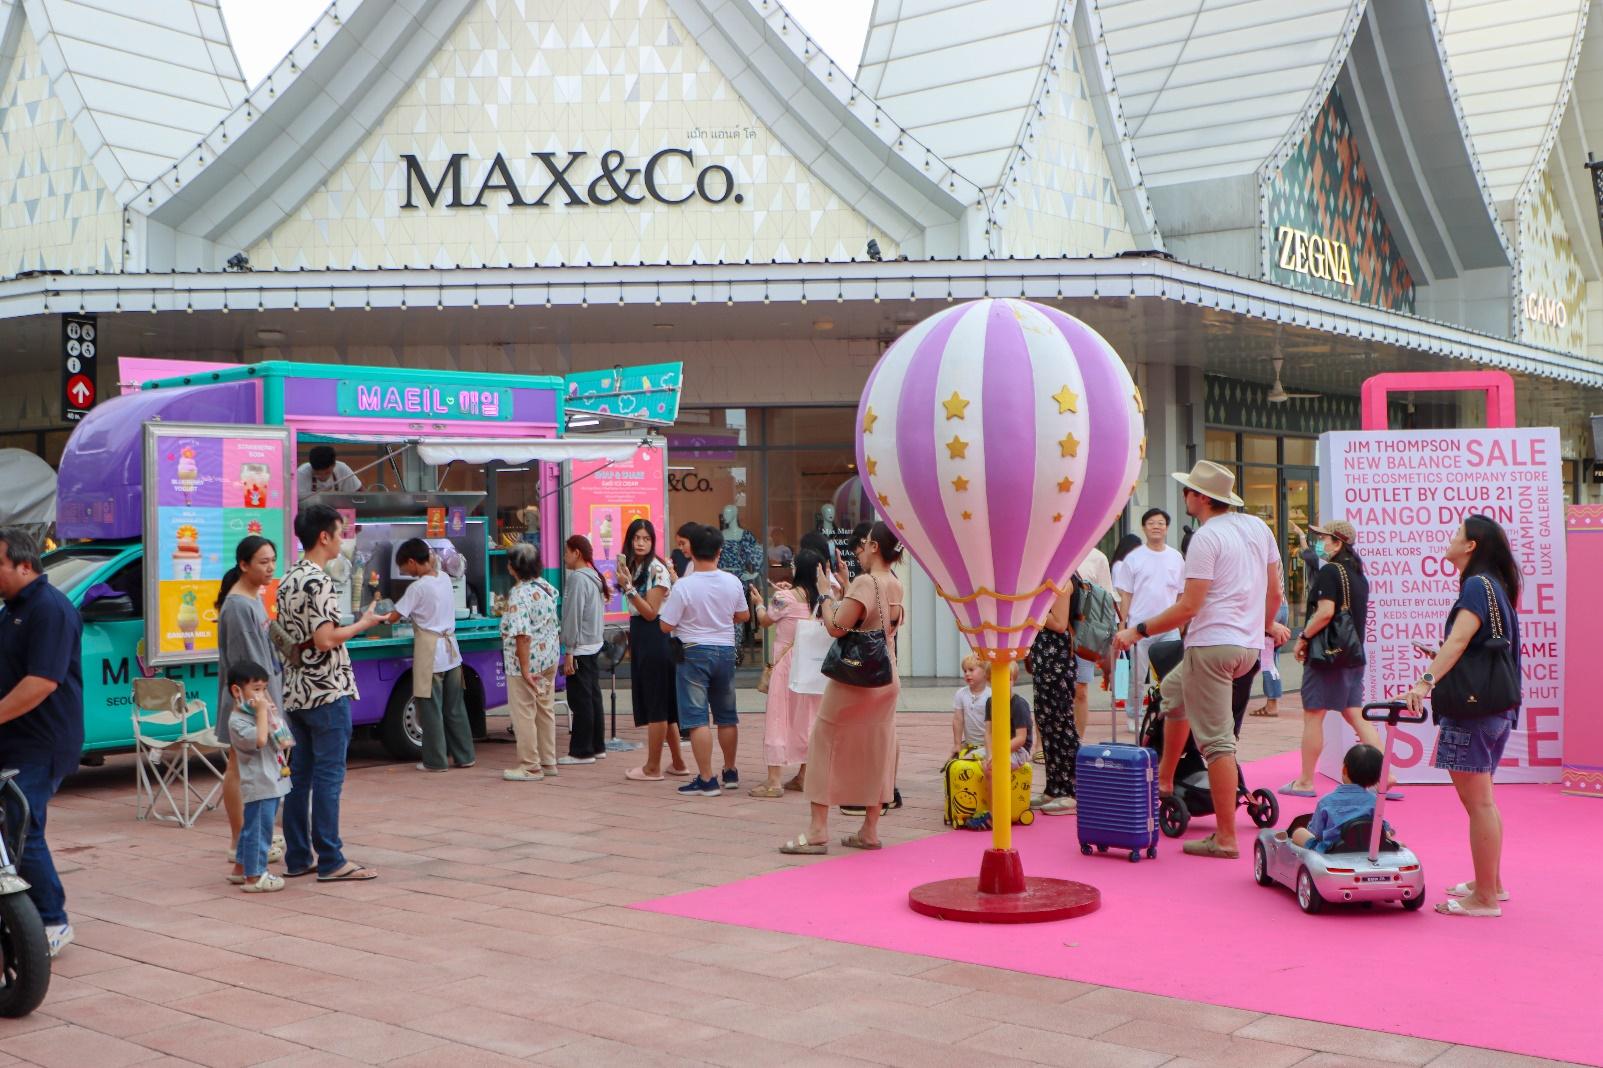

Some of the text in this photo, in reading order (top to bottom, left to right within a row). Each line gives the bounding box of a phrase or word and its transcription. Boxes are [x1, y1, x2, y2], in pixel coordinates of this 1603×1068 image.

[400, 149, 744, 208] MAX&Co.
[1277, 225, 1354, 286] ZEGNA
[357, 385, 448, 413] MAEIL
[1344, 439, 1460, 453] JIM THOMPSON
[1466, 438, 1547, 467] SALE
[1344, 455, 1462, 470] NEW BALANCE
[668, 473, 713, 492] &Co.
[1345, 471, 1548, 484] THE COSMETICS COMPANY STORE
[1345, 486, 1512, 503] OUTLET BY CLUB 21
[1345, 506, 1432, 526] MANGO
[1357, 530, 1454, 544] EDS PLAYBOY
[1518, 485, 1537, 576] CHAMPION
[1537, 485, 1553, 576] LUXE GALERIE
[1357, 547, 1422, 557] CHAEL KORS
[1428, 546, 1450, 554] TUM
[1361, 560, 1413, 576] ASAYA
[1379, 599, 1412, 607] OUTLET
[1427, 598, 1451, 606] CLUB
[1517, 583, 1556, 615] LE
[1383, 610, 1448, 620] KEDS CHAMPI
[1380, 623, 1445, 640] CHARL
[101, 656, 219, 685] MEIL
[1382, 644, 1395, 681] SALE
[1398, 645, 1410, 681] TUMI
[106, 695, 135, 707] SEOU
[1529, 686, 1559, 699] HUT
